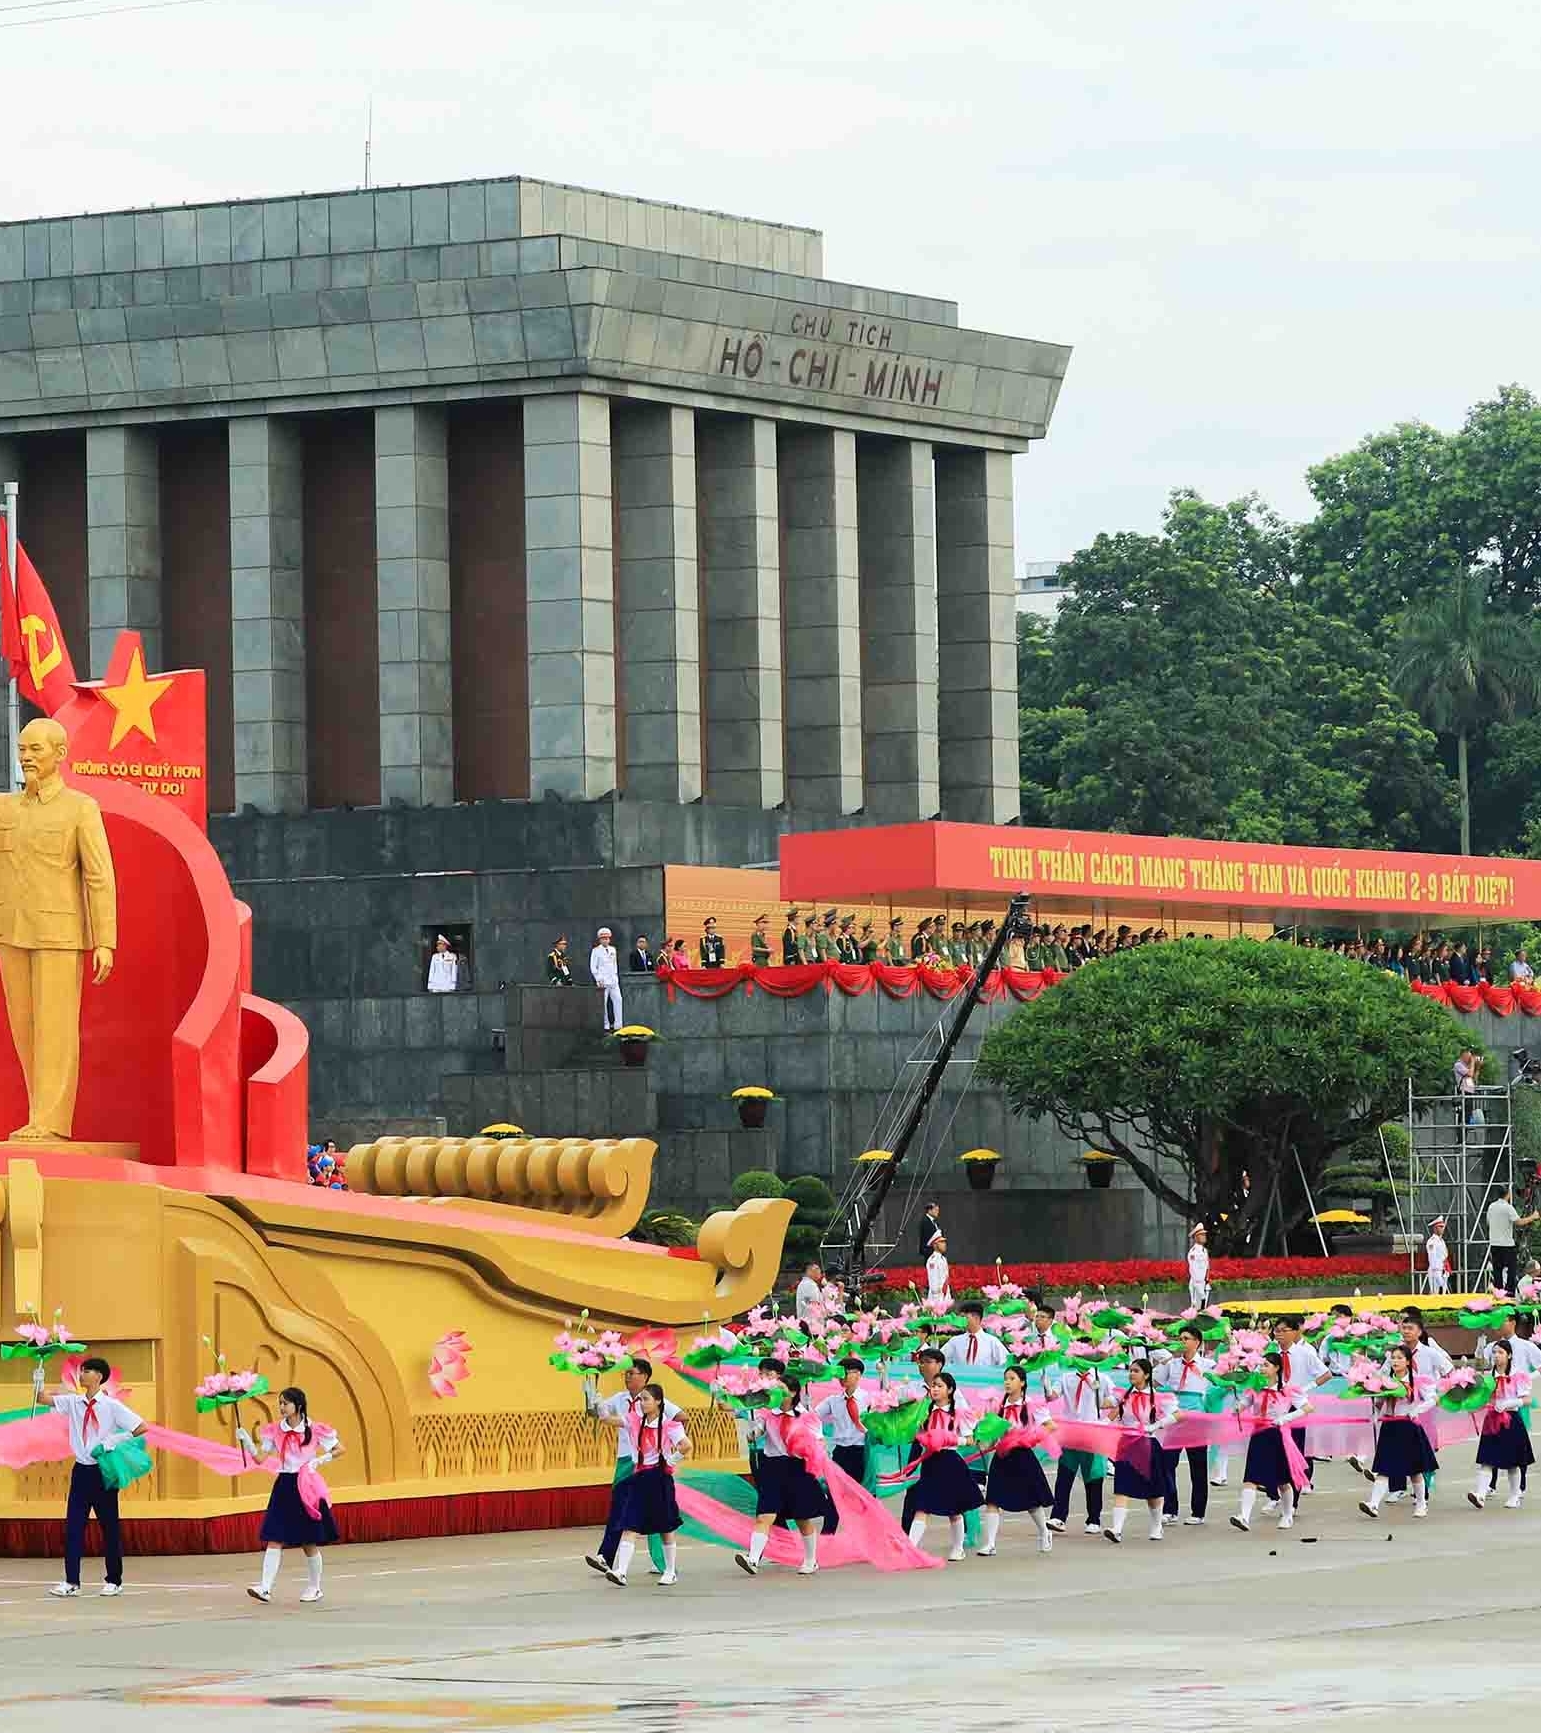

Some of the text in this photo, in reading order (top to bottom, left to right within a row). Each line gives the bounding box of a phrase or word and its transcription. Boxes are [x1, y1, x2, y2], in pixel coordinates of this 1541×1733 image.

[719, 333, 768, 378] HỒ
[864, 354, 944, 406] MINH
[989, 846, 1034, 881] TINH
[1090, 847, 1135, 886] CÁCH
[1139, 855, 1186, 894] MẠNG
[1187, 854, 1244, 893] THÁNG
[1248, 855, 1284, 894] TÁM
[1286, 858, 1308, 897] VÀ
[1311, 857, 1352, 901] QUỐC
[1355, 861, 1407, 901] KHÁNH
[1441, 864, 1471, 904] BẤT
